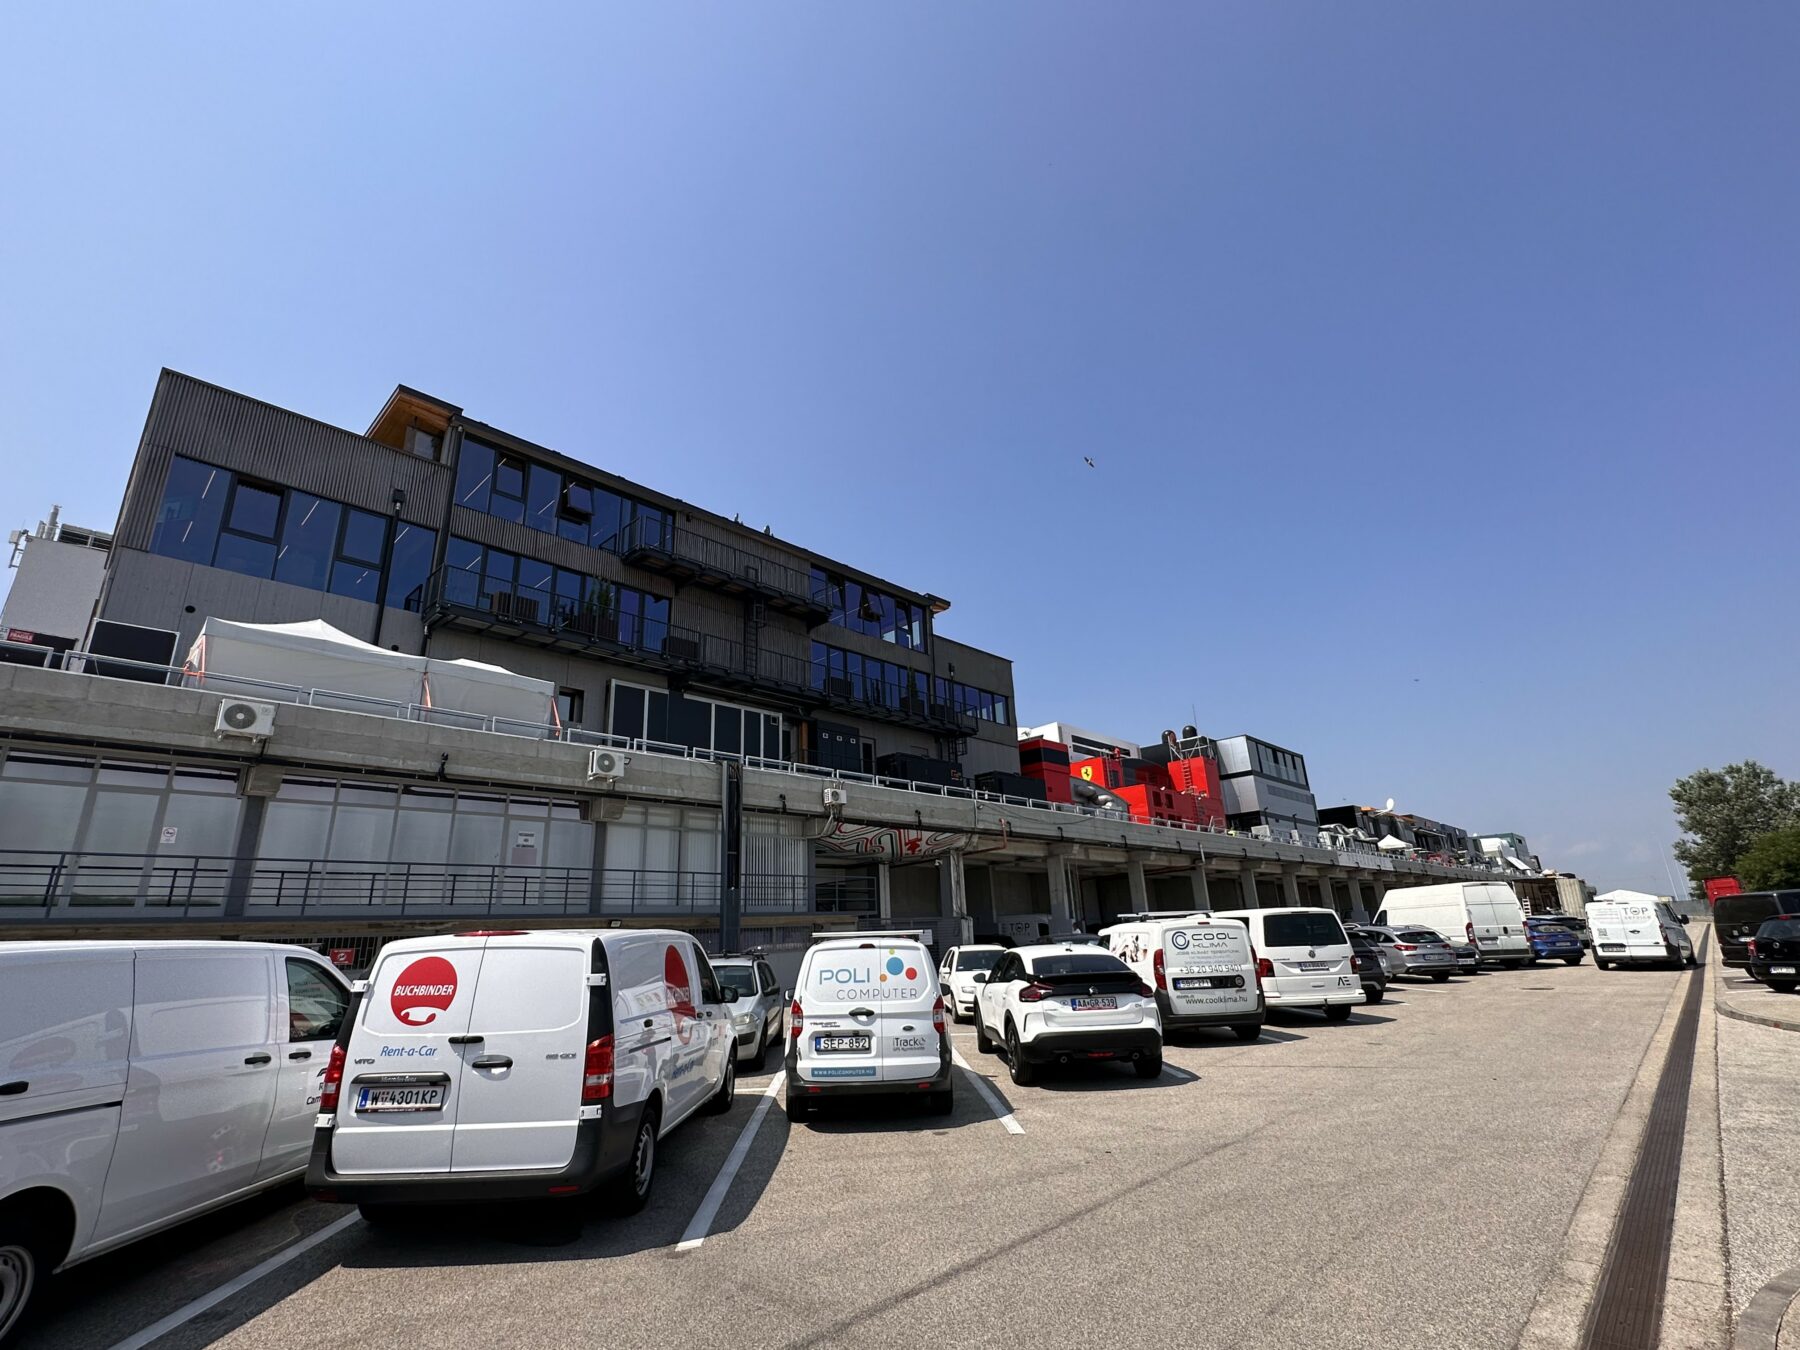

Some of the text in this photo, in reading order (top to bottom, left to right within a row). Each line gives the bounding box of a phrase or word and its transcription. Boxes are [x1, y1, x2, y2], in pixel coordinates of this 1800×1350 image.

[1622, 907, 1648, 915] TOP
[1192, 932, 1238, 941] COOL
[1197, 965, 1207, 974] 20
[1208, 965, 1223, 973] 940
[819, 967, 870, 985] POLI
[394, 984, 455, 996] BUCHBINDER
[836, 987, 918, 1000] COMPUTER
[1186, 995, 1248, 1005] www.coolklima.hu
[823, 1037, 868, 1049] SEP-852
[380, 1045, 438, 1057] Rent-a-Car
